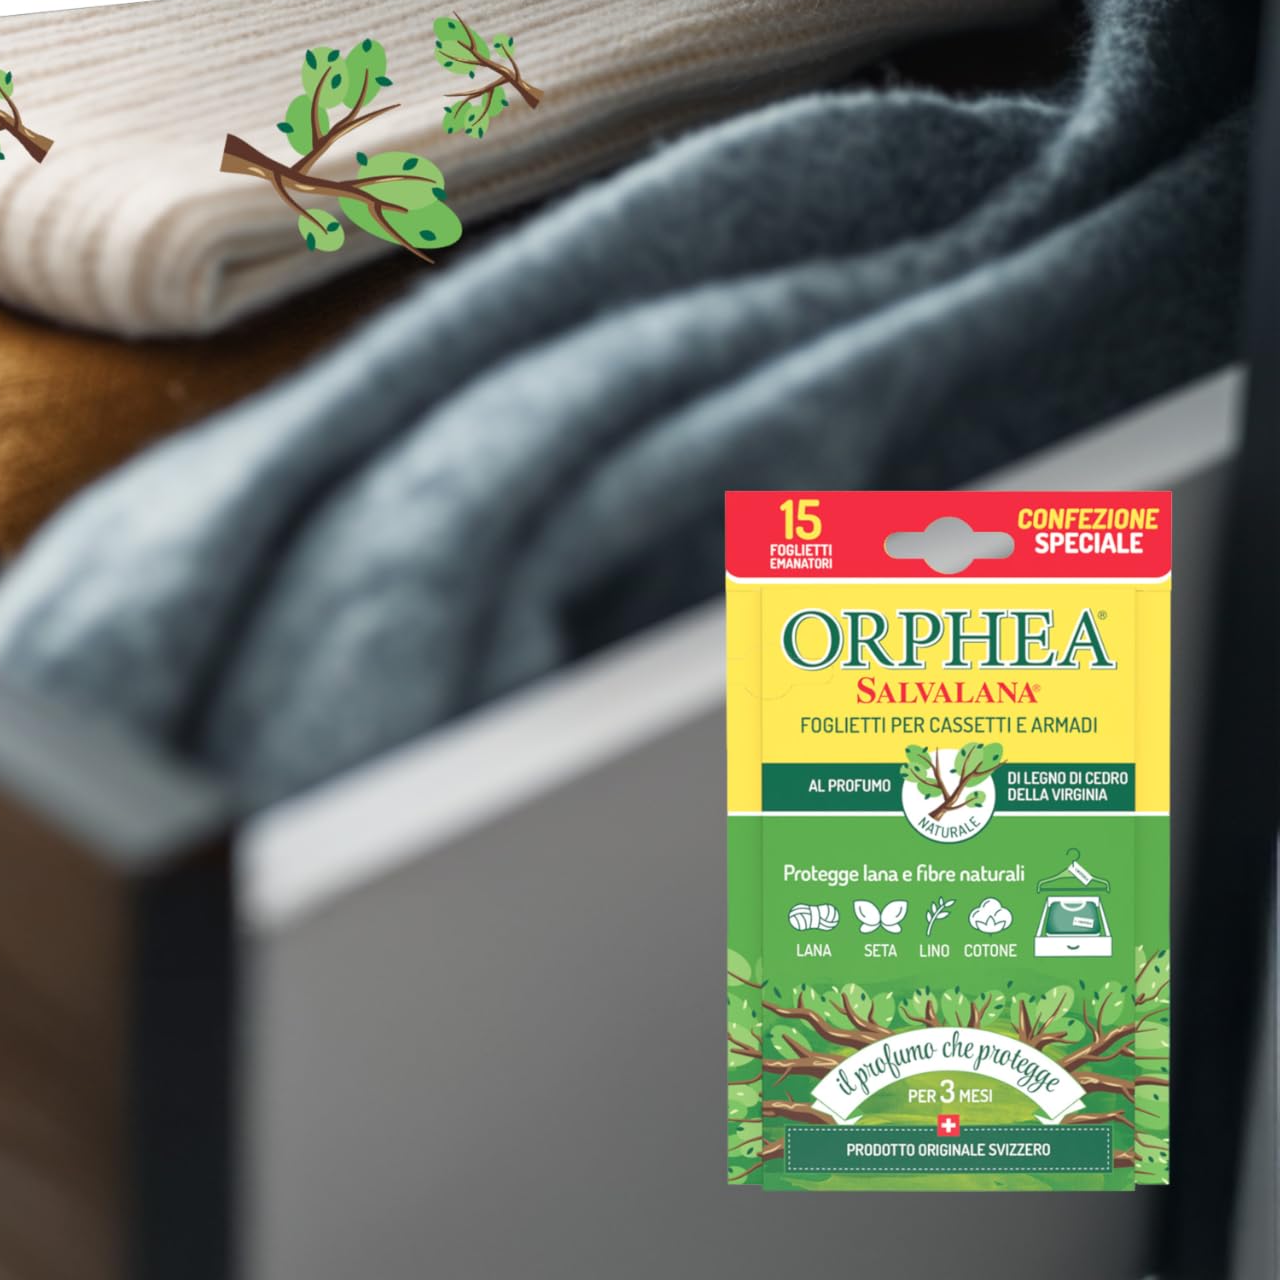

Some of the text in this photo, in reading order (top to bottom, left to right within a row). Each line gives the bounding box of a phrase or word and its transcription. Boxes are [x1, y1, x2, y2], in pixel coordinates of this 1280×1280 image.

[780, 499, 822, 540] 15
[1017, 507, 1159, 530] CONFEZIONE
[770, 544, 833, 557] FOGLIETTI
[1035, 532, 1143, 554] SPECIALE
[770, 558, 833, 569] EMANATORI
[801, 717, 1097, 733] FOGLIETTI PER CASSETTI E ARMADI
[808, 779, 891, 792] AL PROFUMO
[1008, 772, 1129, 785] DI LEGNO DI CEDRO
[1008, 788, 1108, 801] DELLA VIRGINIA
[918, 816, 981, 838] NATURALE
[784, 864, 1025, 886] Protegge lana e fibre naturali
[796, 943, 832, 958] LANA
[864, 943, 897, 958] SETA
[919, 943, 950, 958] LINO
[964, 943, 1017, 958] COTONE
[836, 1030, 1060, 1095] il profumo che protegge
[908, 1079, 992, 1103] PER 3 MESI
[846, 1143, 1051, 1157] PRODOTTO ORIGINALE SVIZZERO
